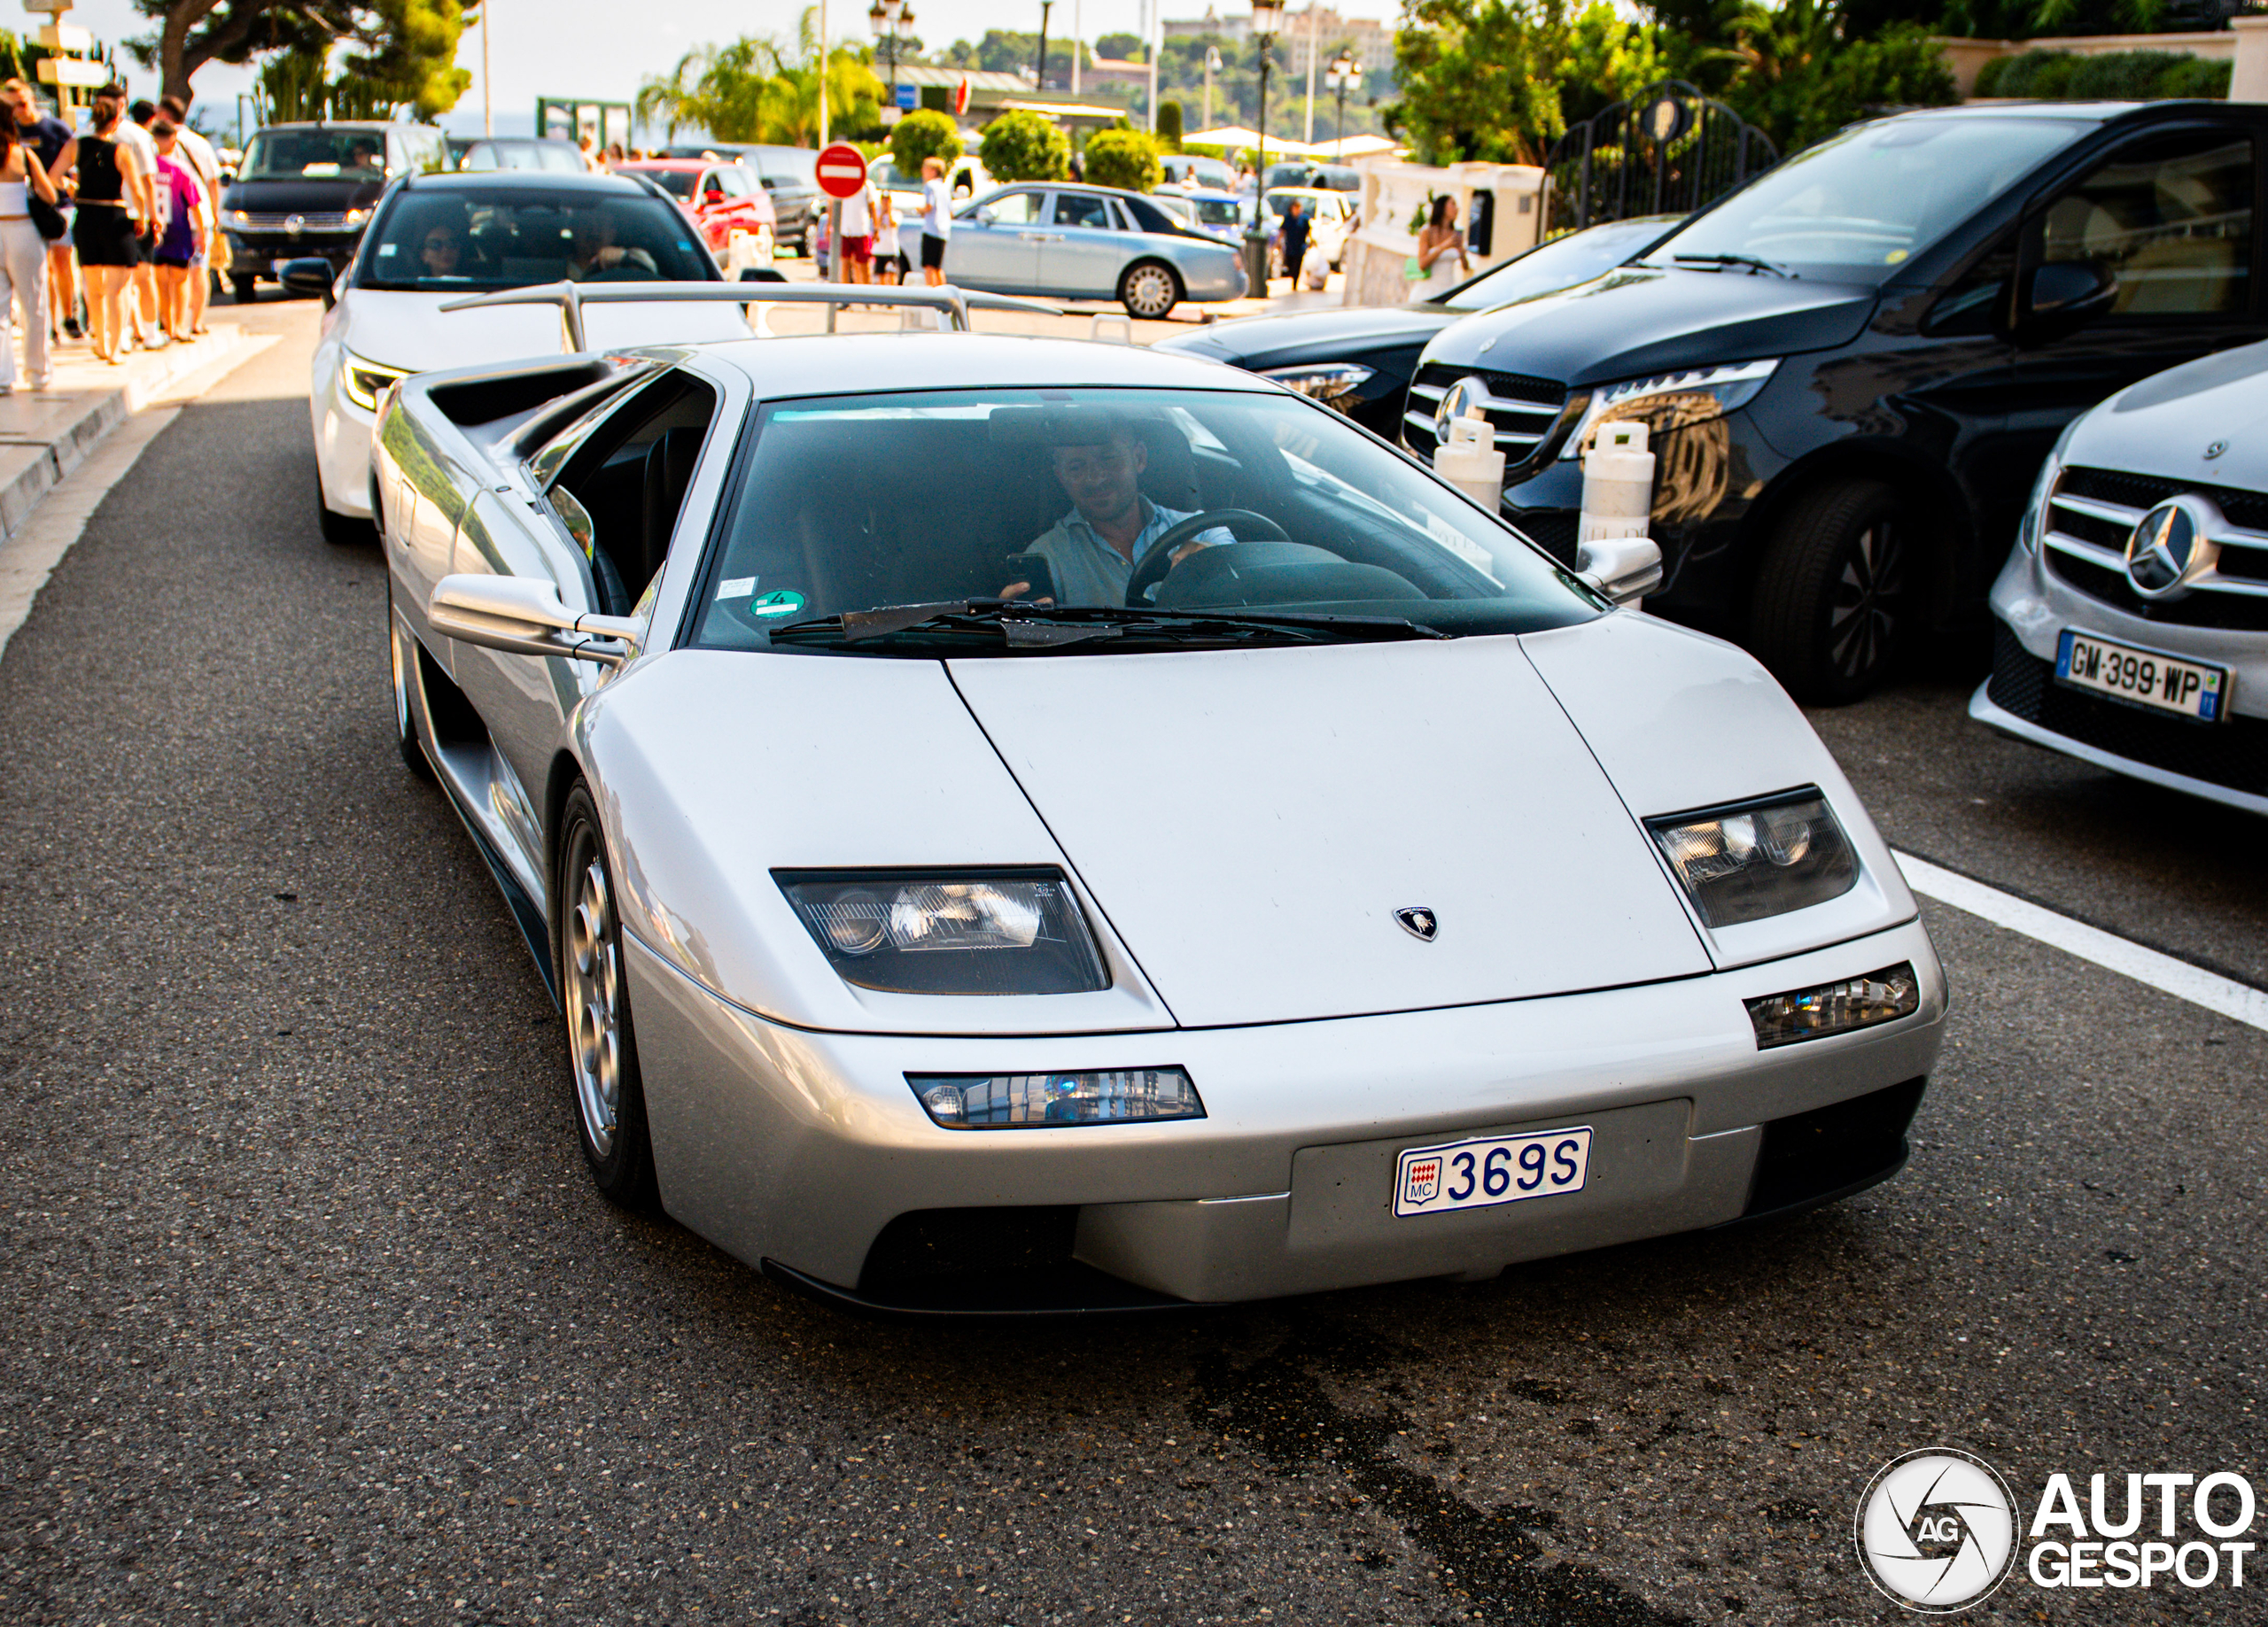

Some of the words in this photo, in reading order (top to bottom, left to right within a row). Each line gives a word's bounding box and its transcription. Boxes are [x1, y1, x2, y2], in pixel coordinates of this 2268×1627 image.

[770, 592, 786, 604] 4
[1448, 1139, 1580, 1201] 369S
[1410, 1182, 1433, 1197] MC
